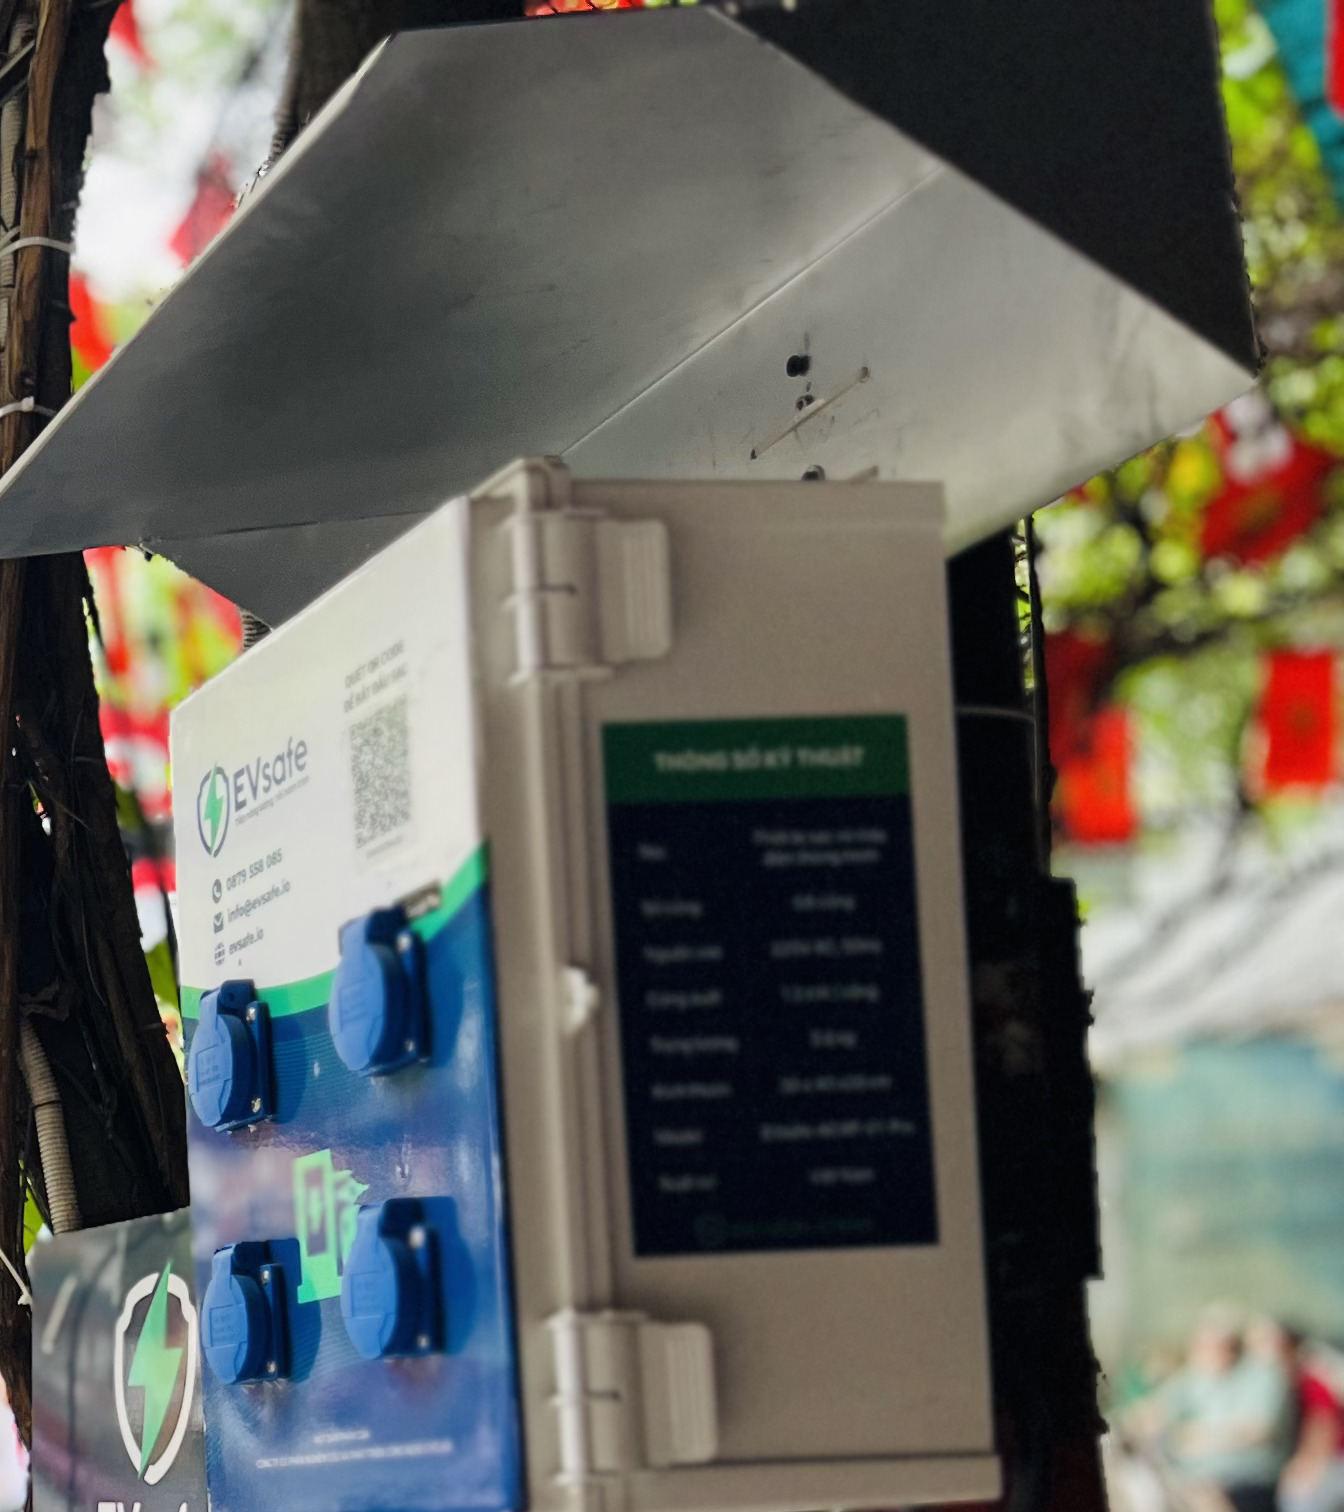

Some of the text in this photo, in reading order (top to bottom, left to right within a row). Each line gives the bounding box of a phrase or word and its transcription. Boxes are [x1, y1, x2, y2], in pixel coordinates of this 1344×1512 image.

[233, 735, 308, 813] EVsafe
[227, 878, 291, 924] info@evsafe.io
[229, 926, 264, 955] evsafe.io
